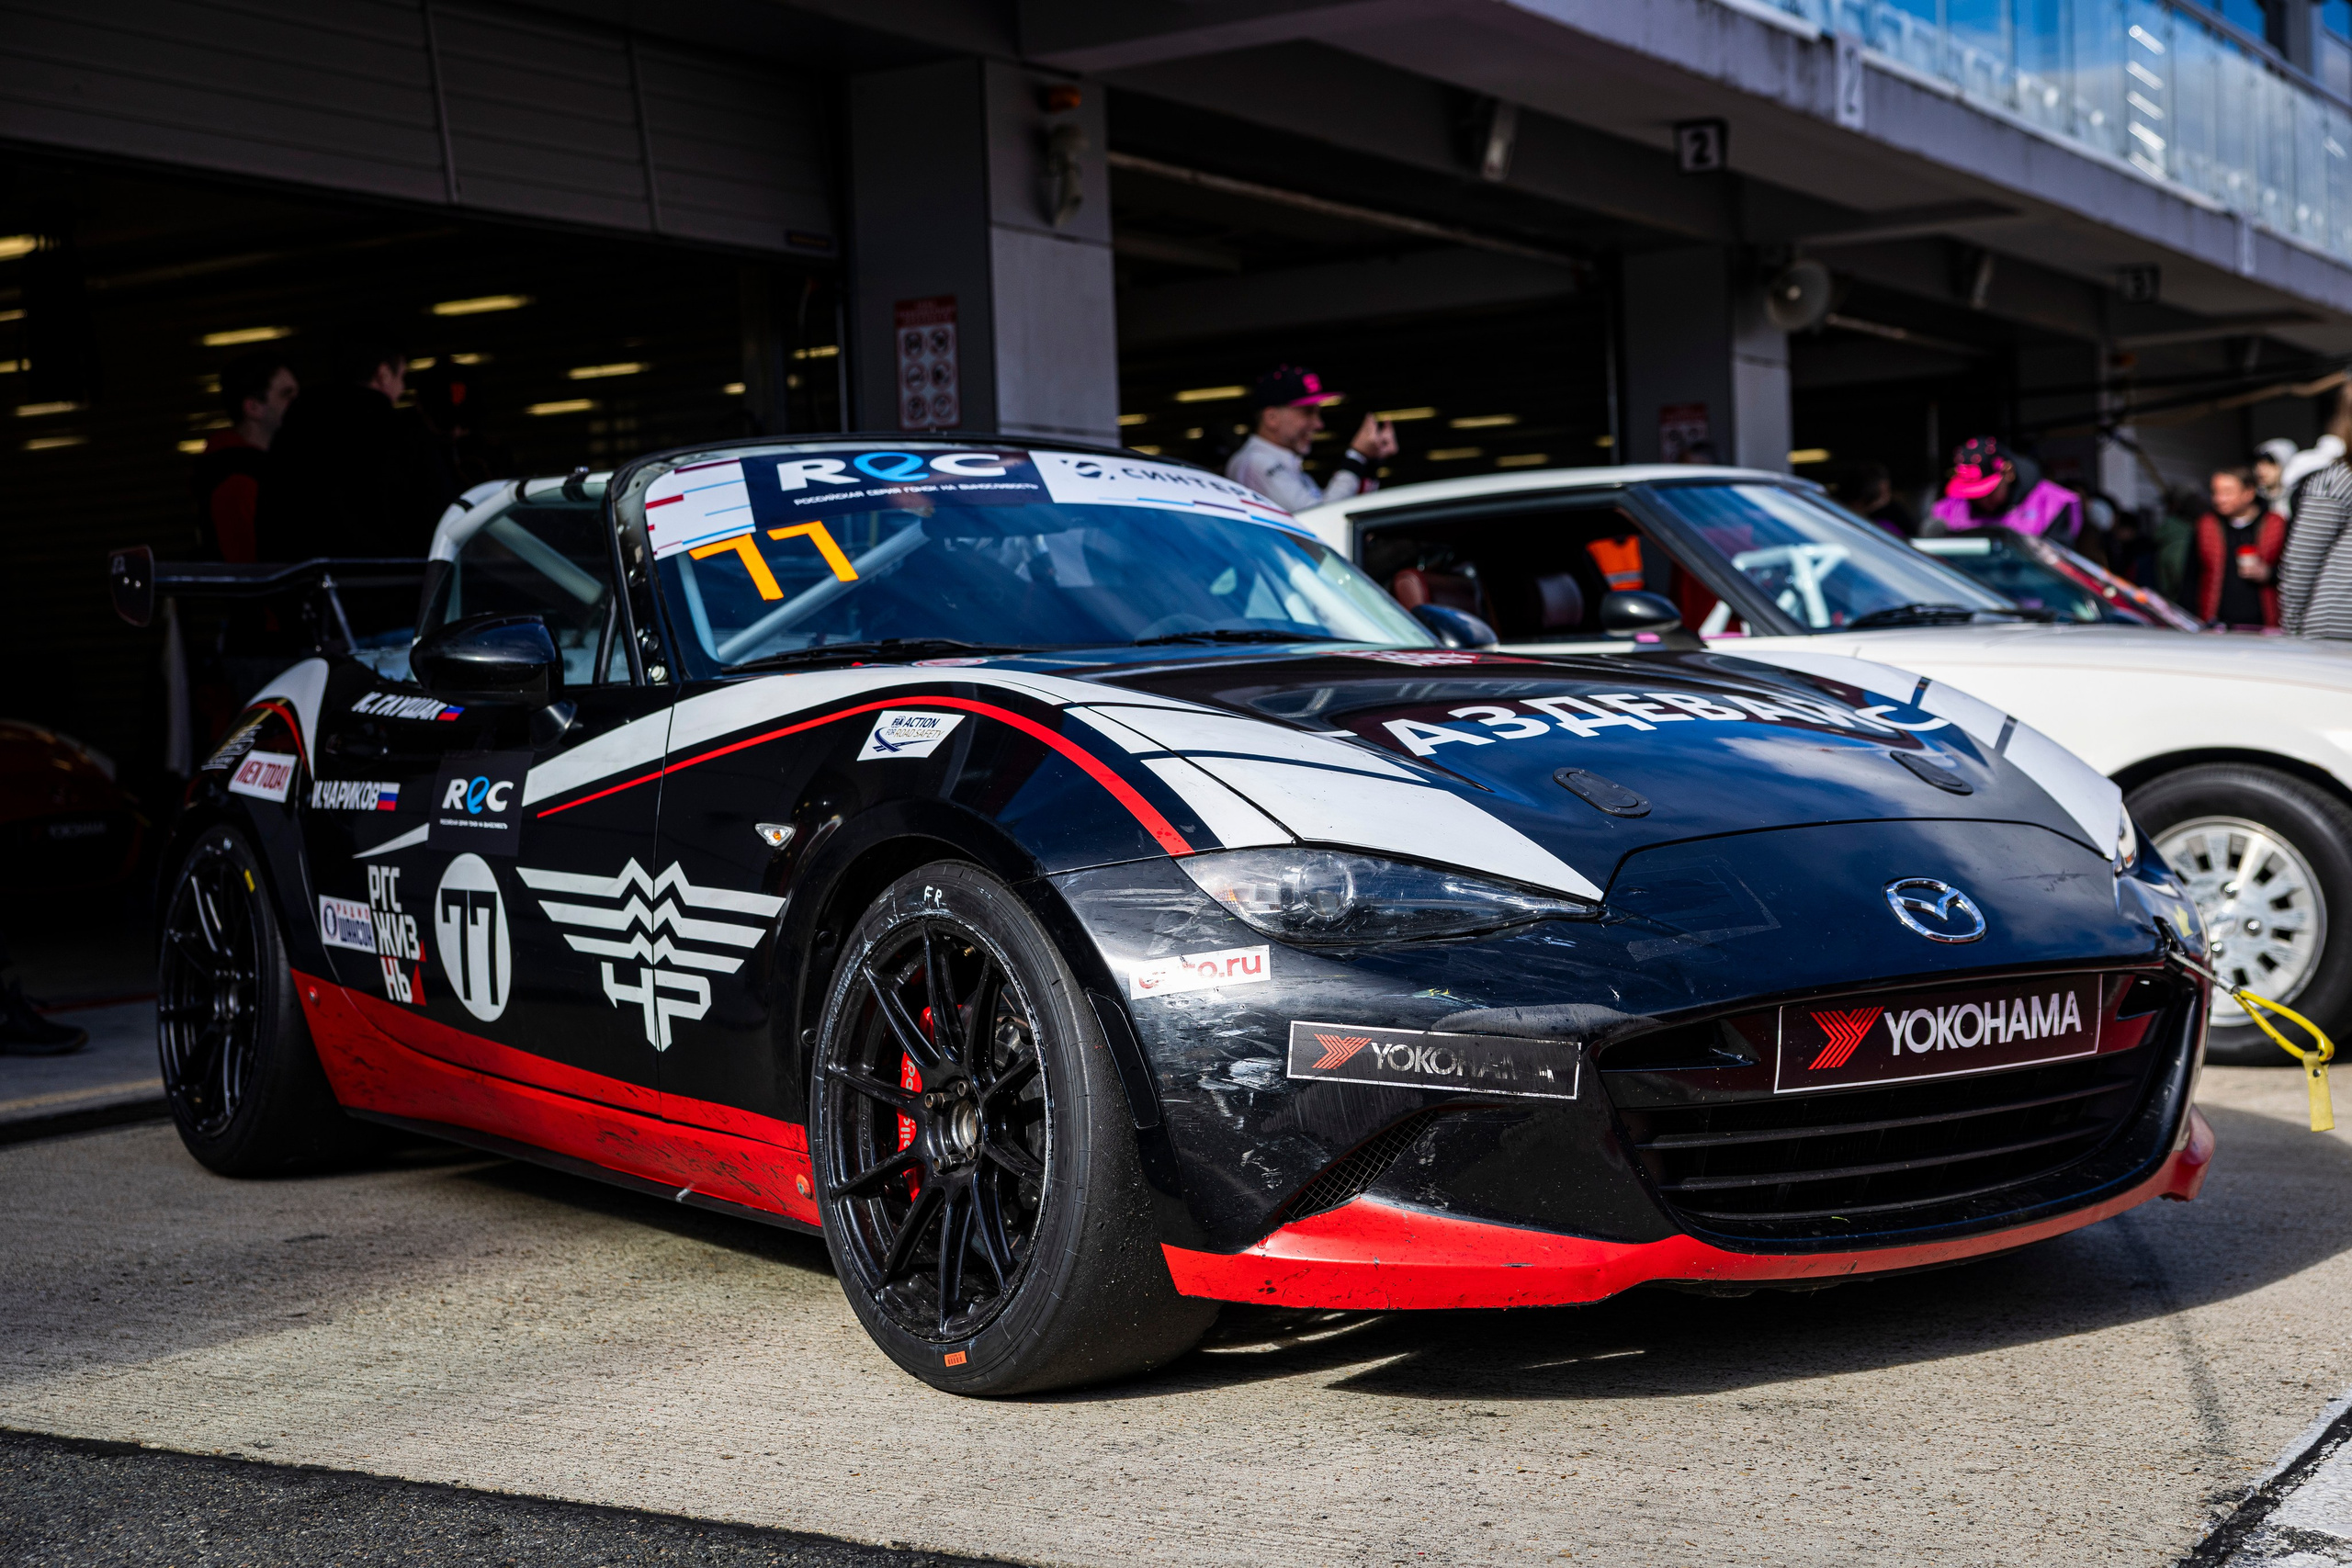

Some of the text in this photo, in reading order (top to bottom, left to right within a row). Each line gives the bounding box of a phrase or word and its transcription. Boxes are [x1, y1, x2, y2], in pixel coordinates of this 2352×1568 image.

[1690, 131, 1712, 165] 2
[793, 491, 865, 506] РОССИЙСКАЯ
[865, 487, 902, 497] СЕРИЯ
[688, 520, 860, 602] 77
[894, 728, 916, 738] ROAD
[913, 728, 945, 739] SAFETY
[902, 716, 941, 728] ACTION
[311, 779, 381, 811] И.ЧАРИКОВ
[368, 864, 402, 913] РГС
[335, 902, 369, 921] РАДИО
[338, 917, 374, 949] ШАНСОН
[373, 911, 421, 961] ЖИЗ
[440, 887, 500, 1007] 77
[380, 956, 413, 1004] НЬ
[1883, 990, 2083, 1056] YOKOHAMA
[1371, 1042, 1555, 1084] YOKO
